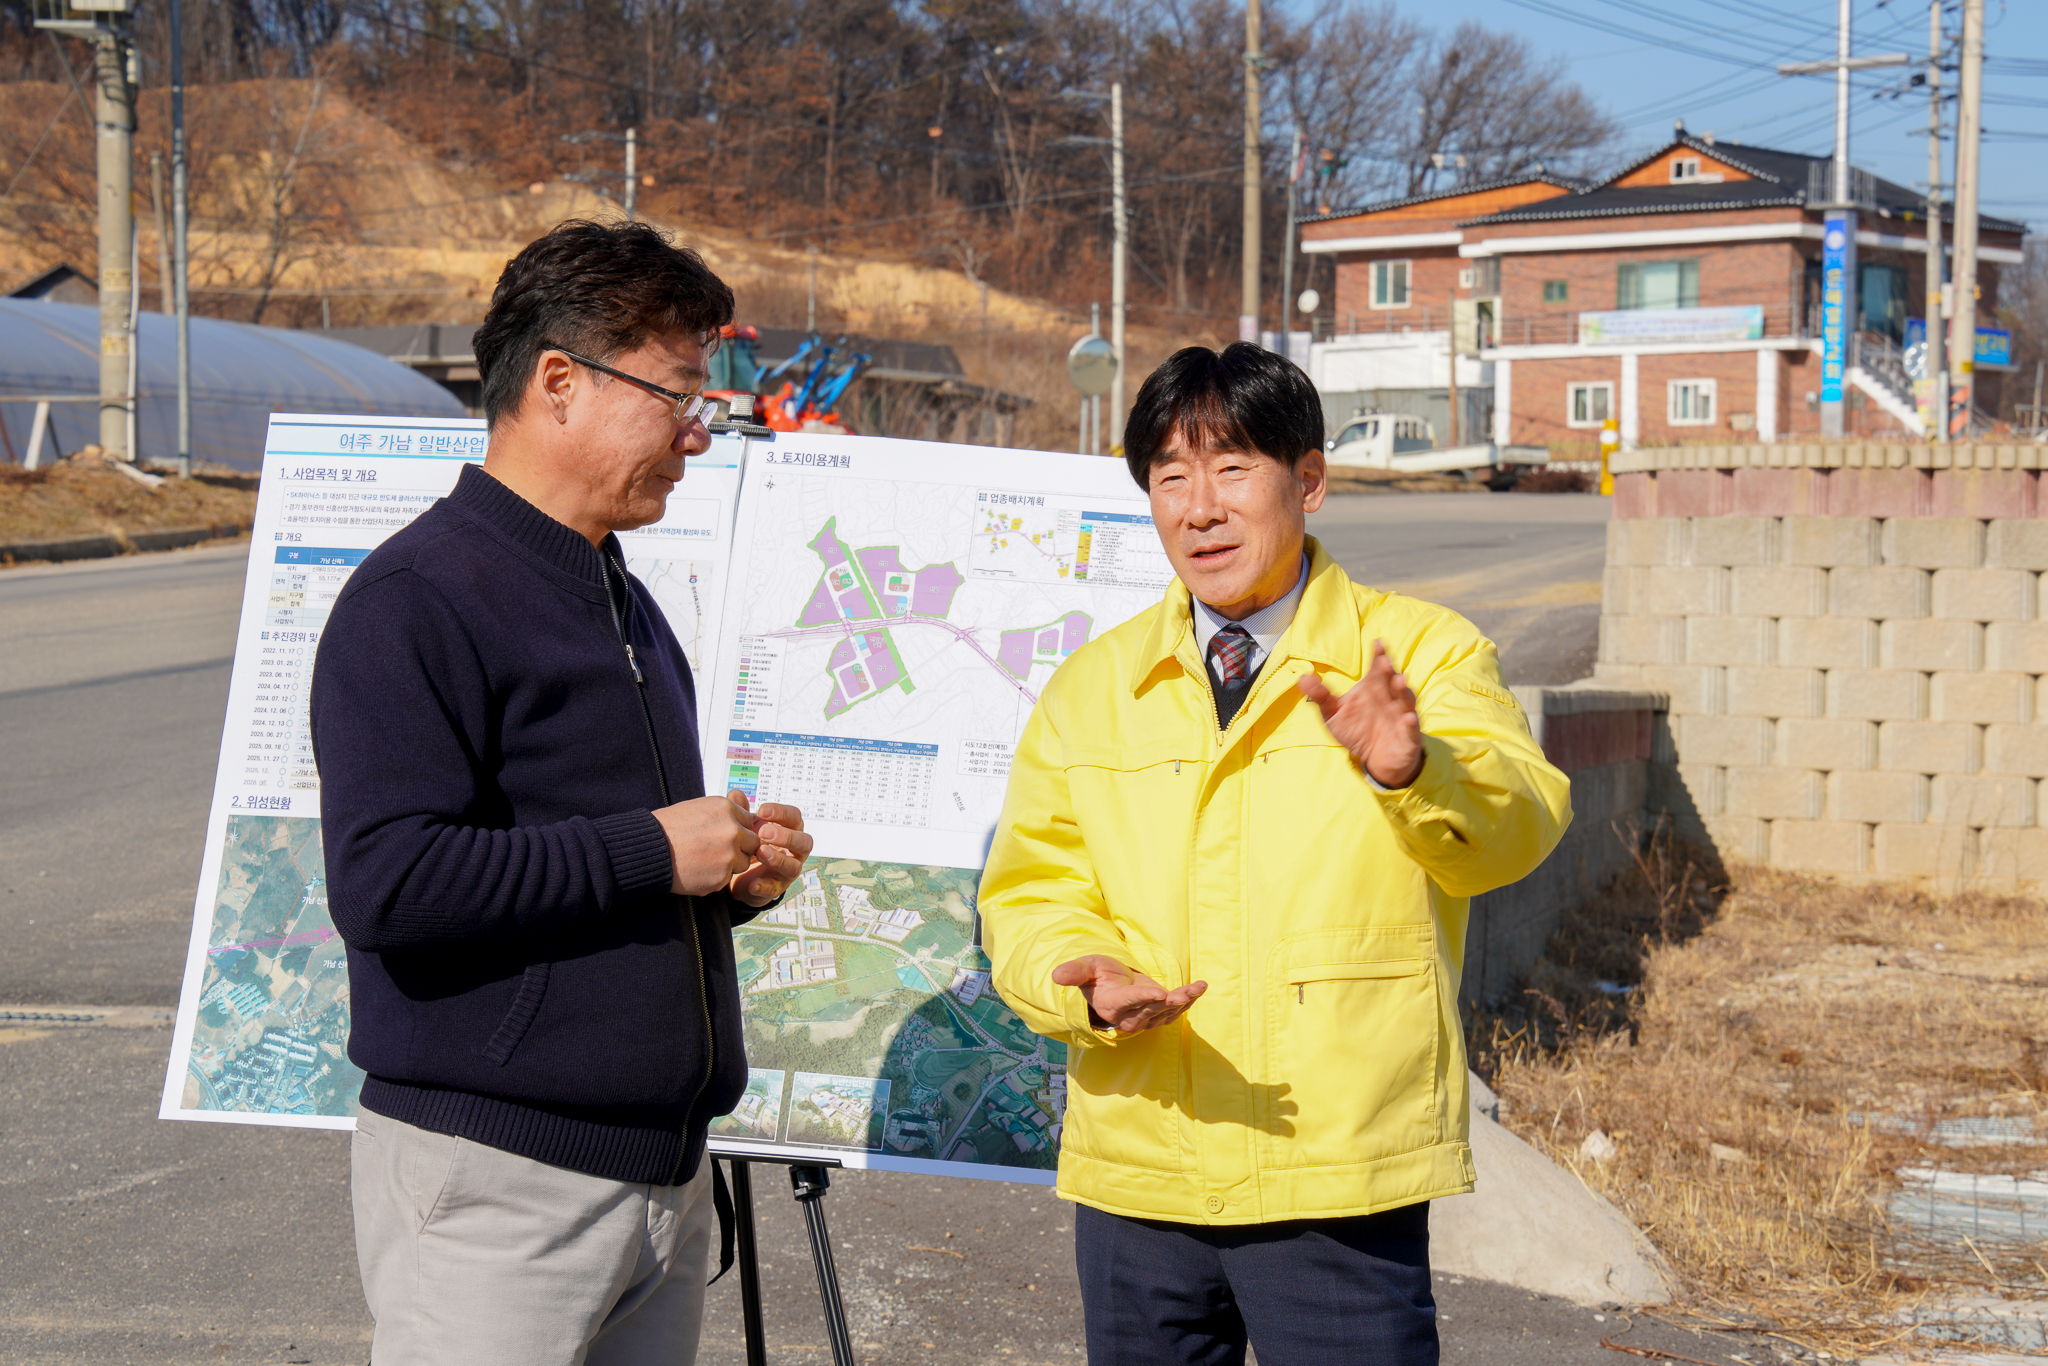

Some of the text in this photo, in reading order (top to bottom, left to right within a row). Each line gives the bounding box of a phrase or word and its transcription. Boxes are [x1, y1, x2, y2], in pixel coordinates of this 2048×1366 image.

[340, 433, 488, 454] 여주 가남 일반산업
[766, 452, 851, 468] 3. 토지이용계획
[280, 468, 377, 482] 1. 사업목적 및 개요
[990, 494, 1044, 506] 업종배치계획
[286, 533, 302, 542] 개요
[272, 632, 318, 642] 추진경위 및
[232, 796, 292, 809] 2. 위성현황
[302, 896, 315, 904] 가남
[323, 960, 336, 968] 가남
